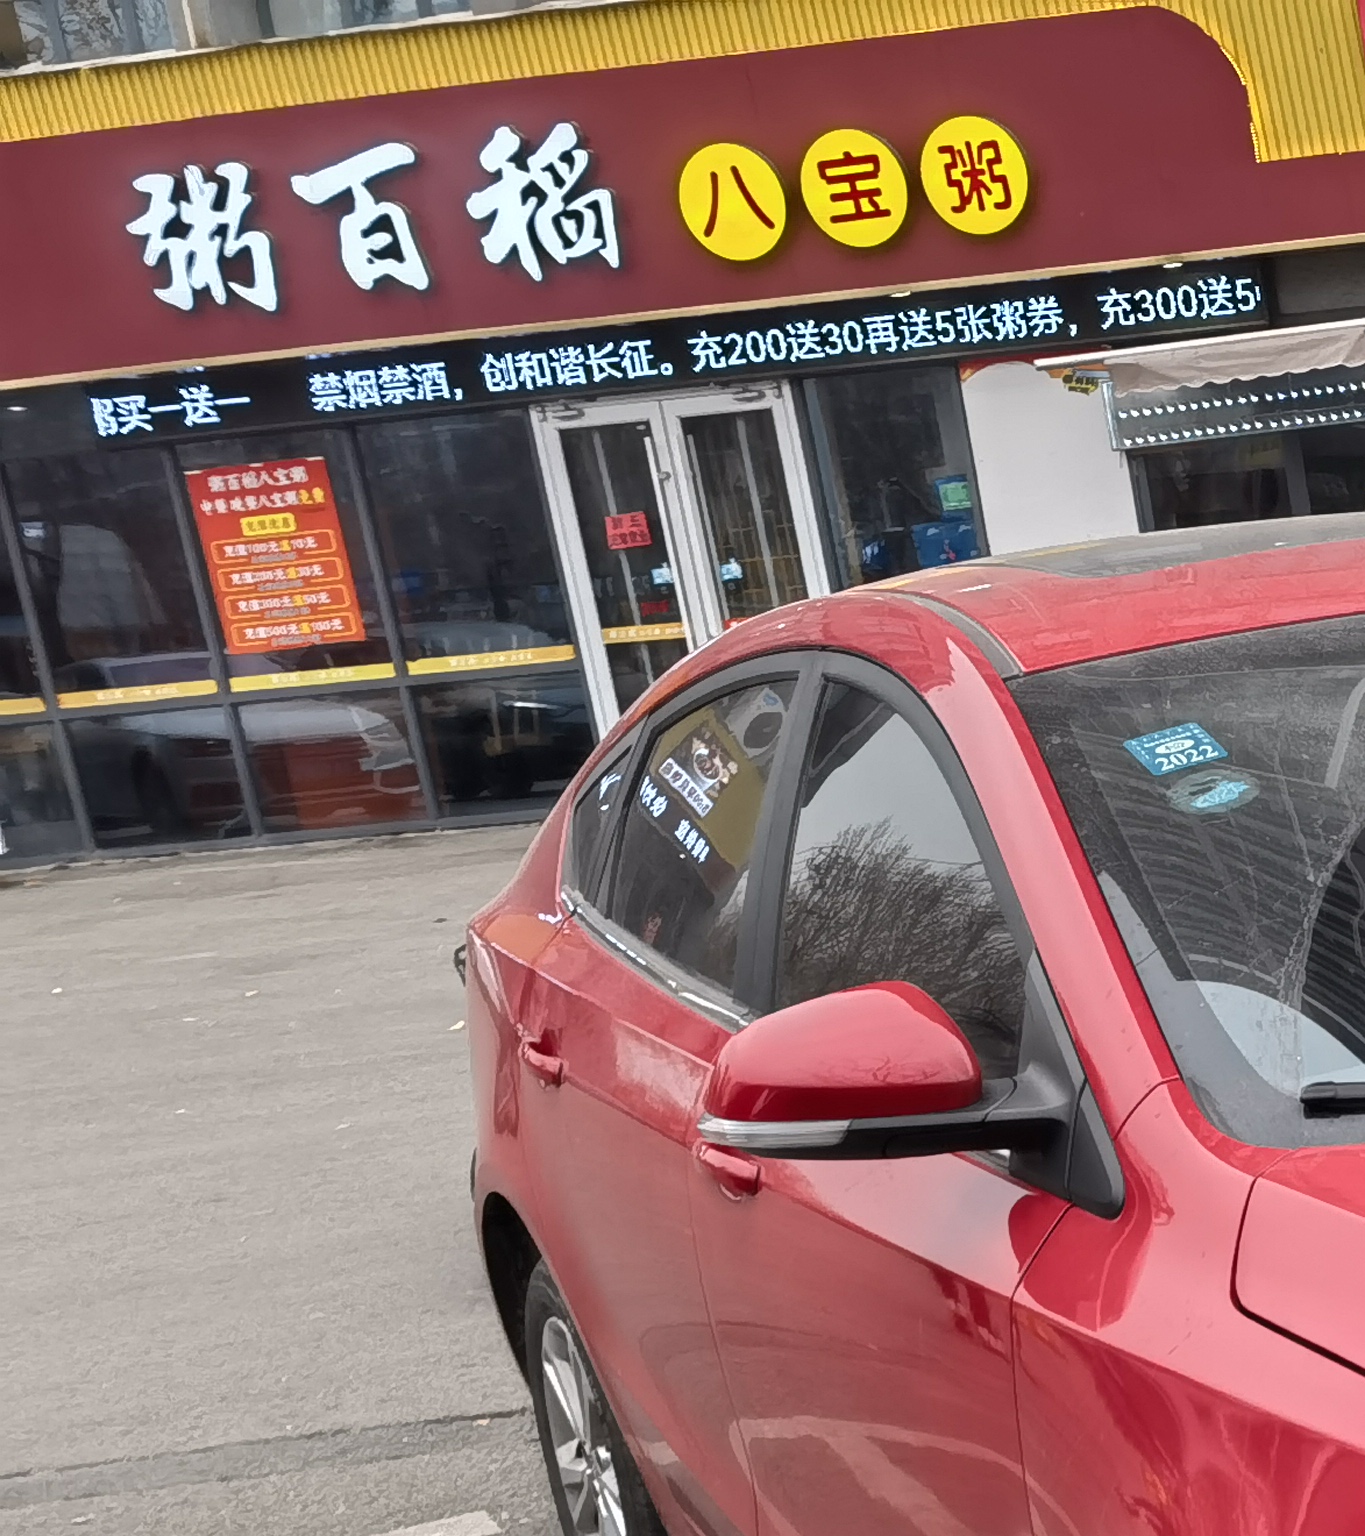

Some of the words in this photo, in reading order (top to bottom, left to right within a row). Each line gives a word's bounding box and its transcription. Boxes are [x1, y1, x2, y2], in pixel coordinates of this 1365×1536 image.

[702, 138, 1013, 236] 八宝粥
[1154, 745, 1219, 772] 2022
